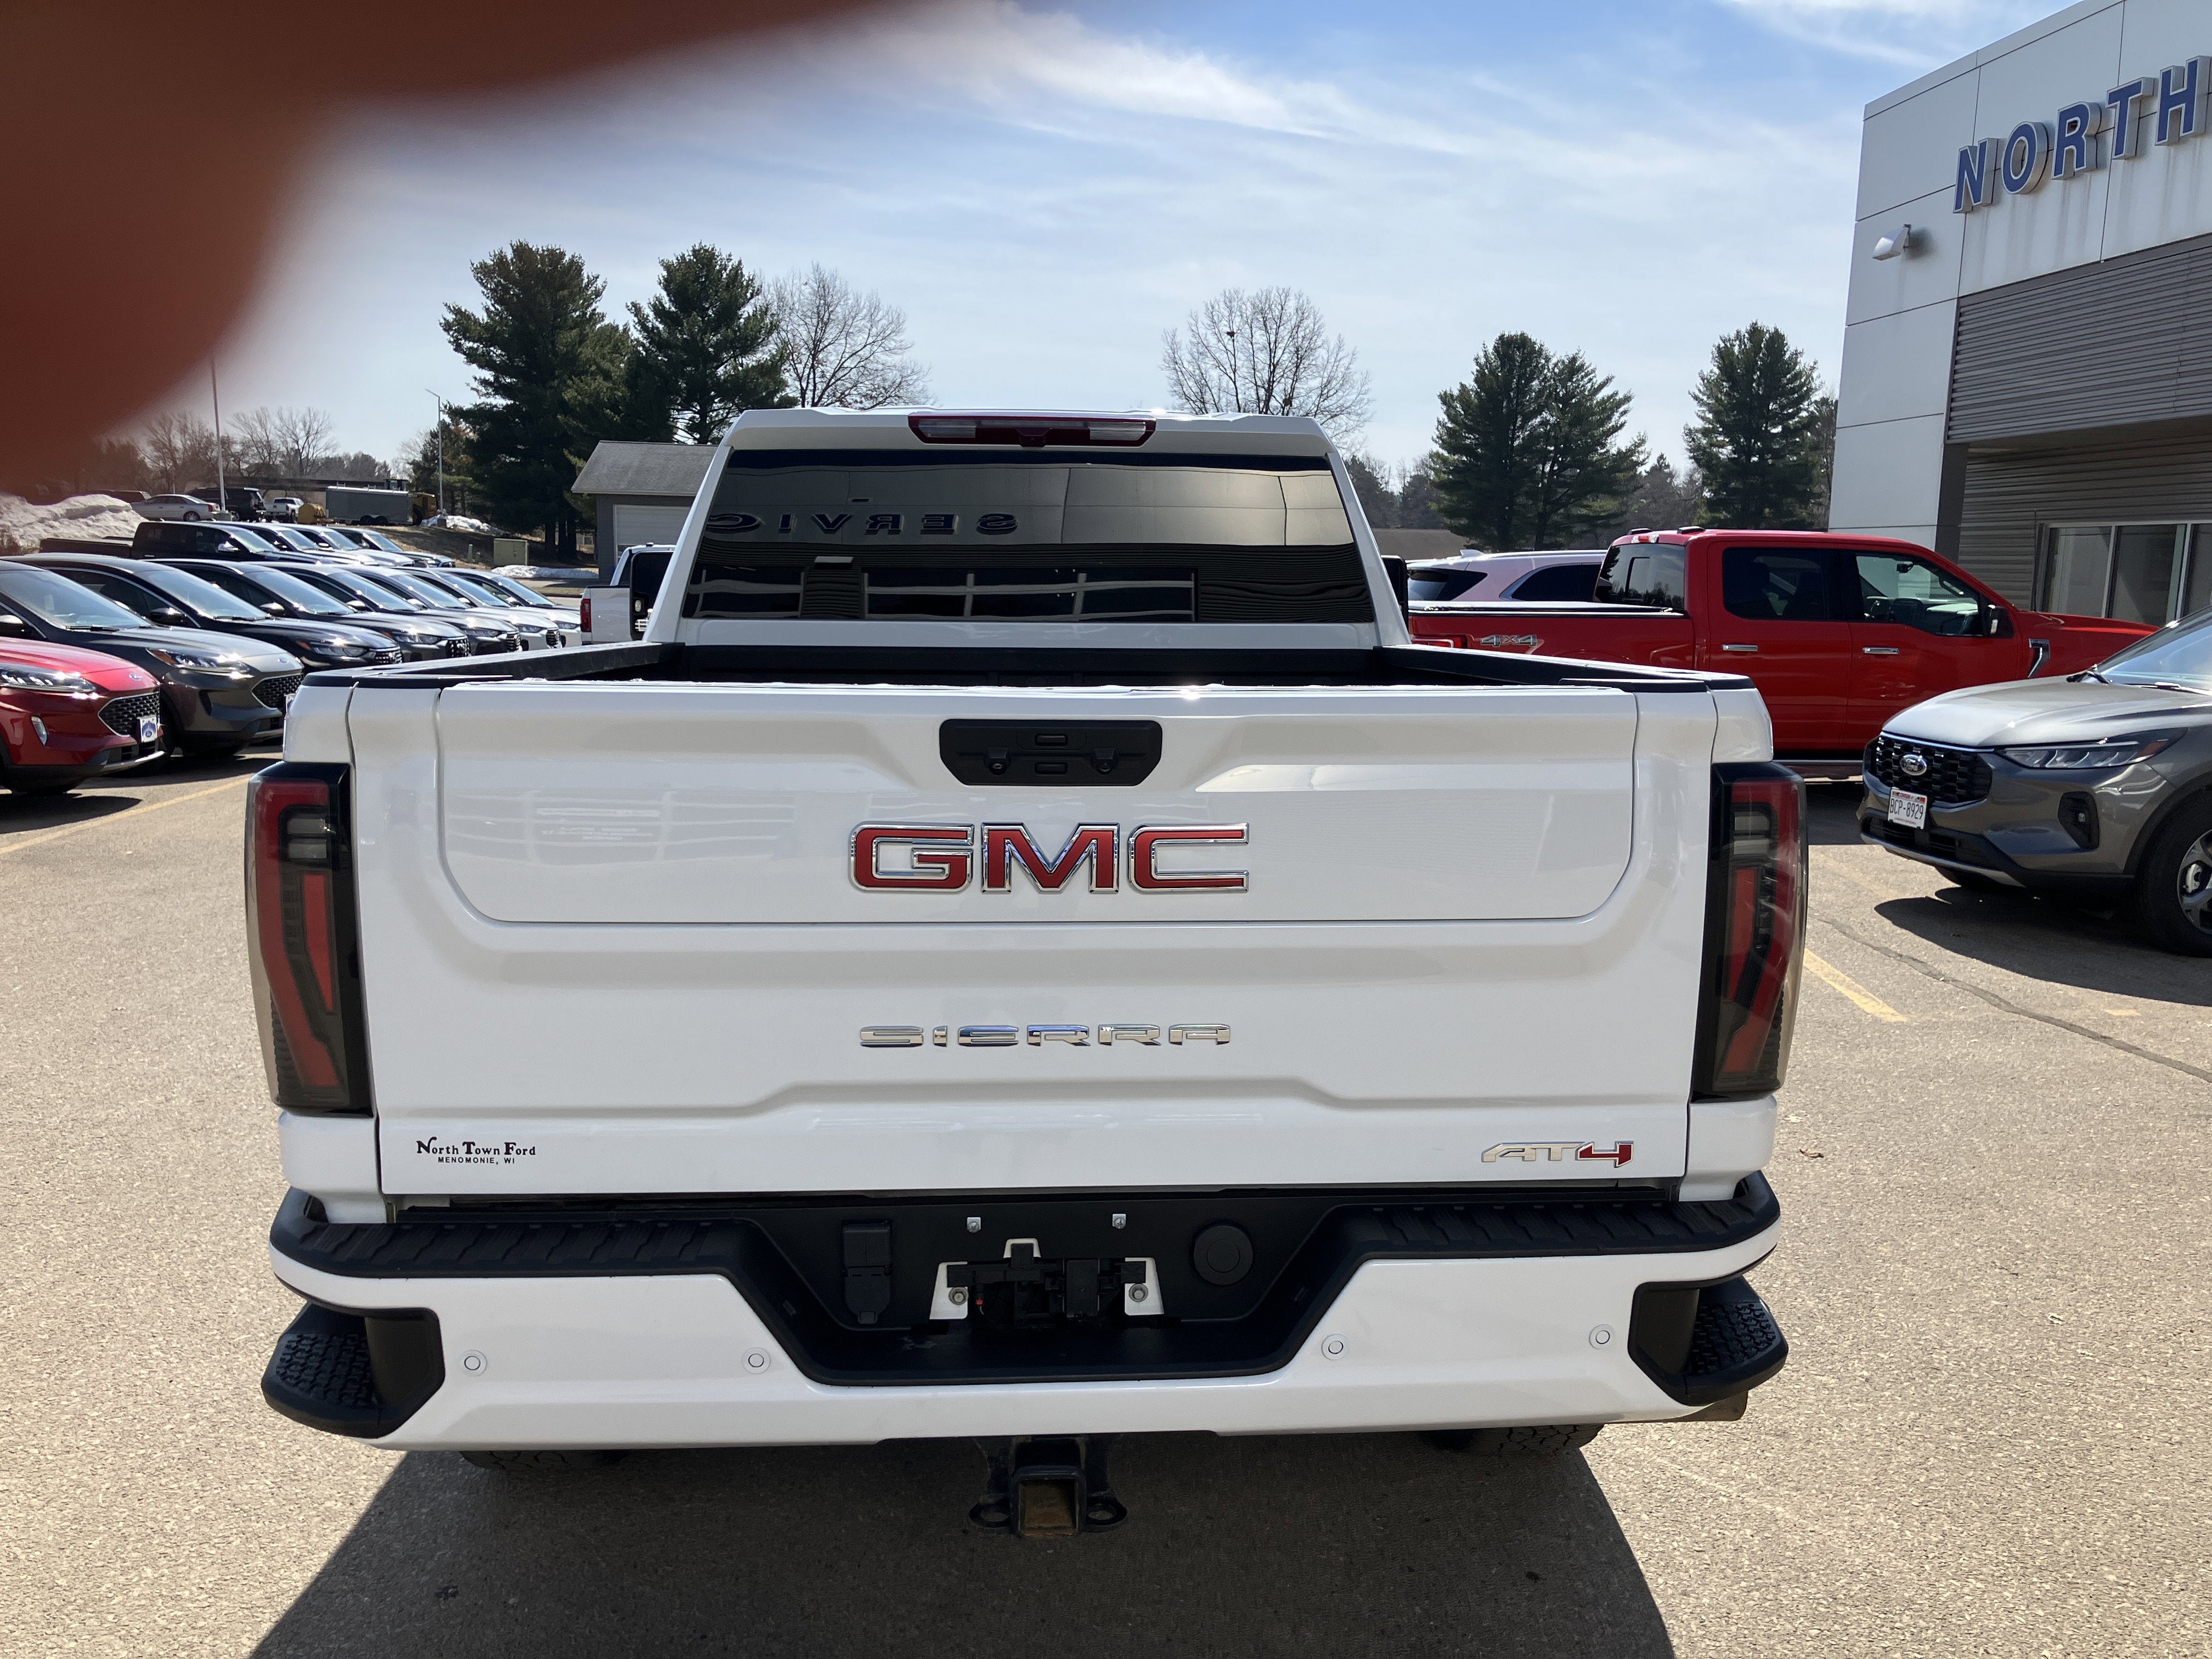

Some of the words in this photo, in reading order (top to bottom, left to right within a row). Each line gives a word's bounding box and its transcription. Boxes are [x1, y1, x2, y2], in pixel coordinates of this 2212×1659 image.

[1953, 55, 2211, 213] NORTH
[1890, 798, 1924, 820] BCP-8929
[849, 822, 1250, 893] GMC
[860, 1024, 1231, 1048] SIERRA
[416, 1136, 459, 1154] North
[462, 1141, 500, 1155] Town
[504, 1142, 536, 1155] Ford
[1481, 1141, 1634, 1168] AT4
[438, 1156, 499, 1165] MENOMONIE,
